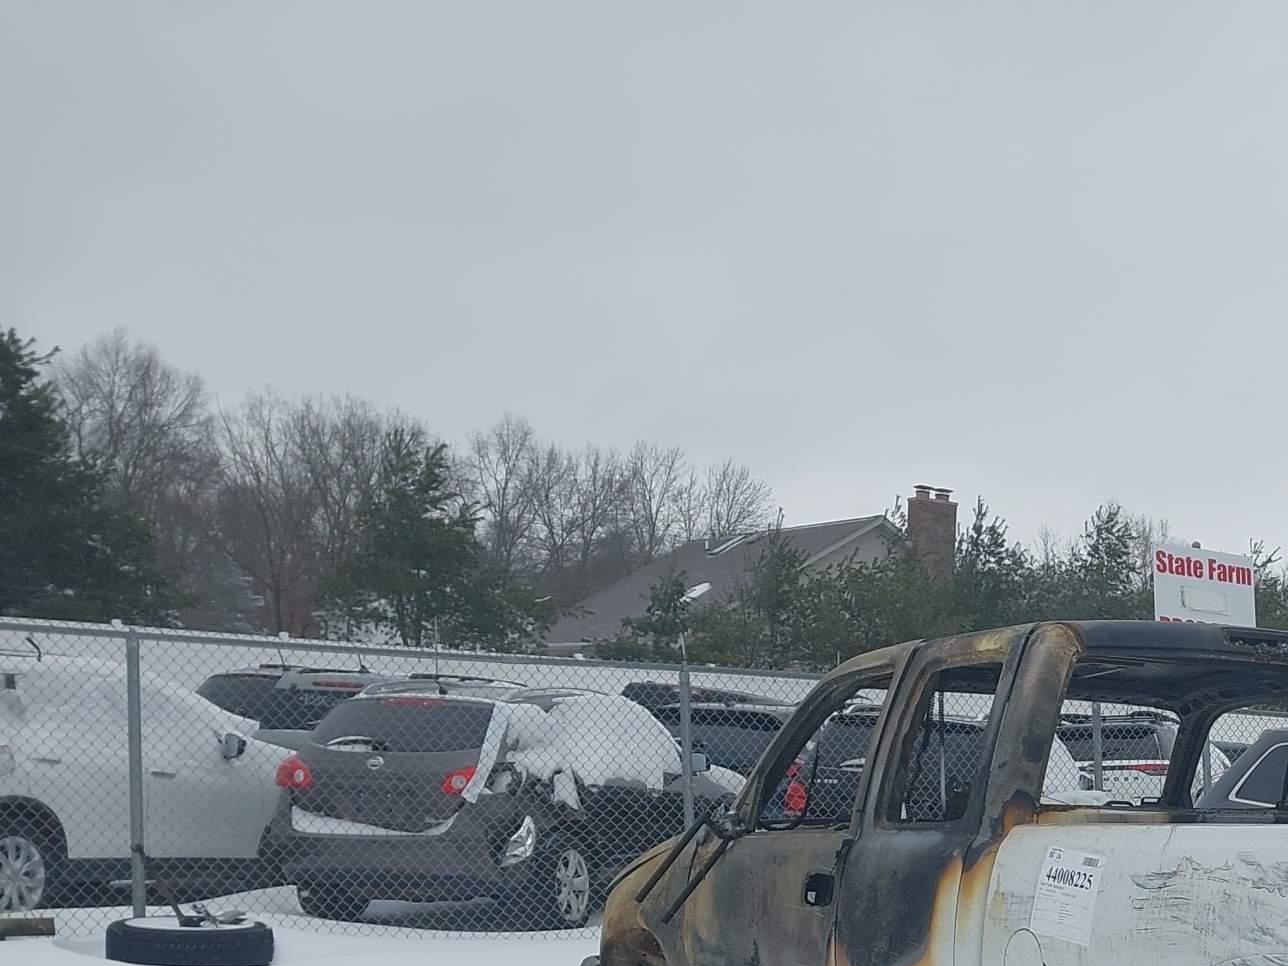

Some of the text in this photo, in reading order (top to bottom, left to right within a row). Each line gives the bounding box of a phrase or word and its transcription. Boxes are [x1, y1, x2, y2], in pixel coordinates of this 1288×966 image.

[1156, 551, 1252, 585] State Farm
[1046, 866, 1093, 890] 44008225
